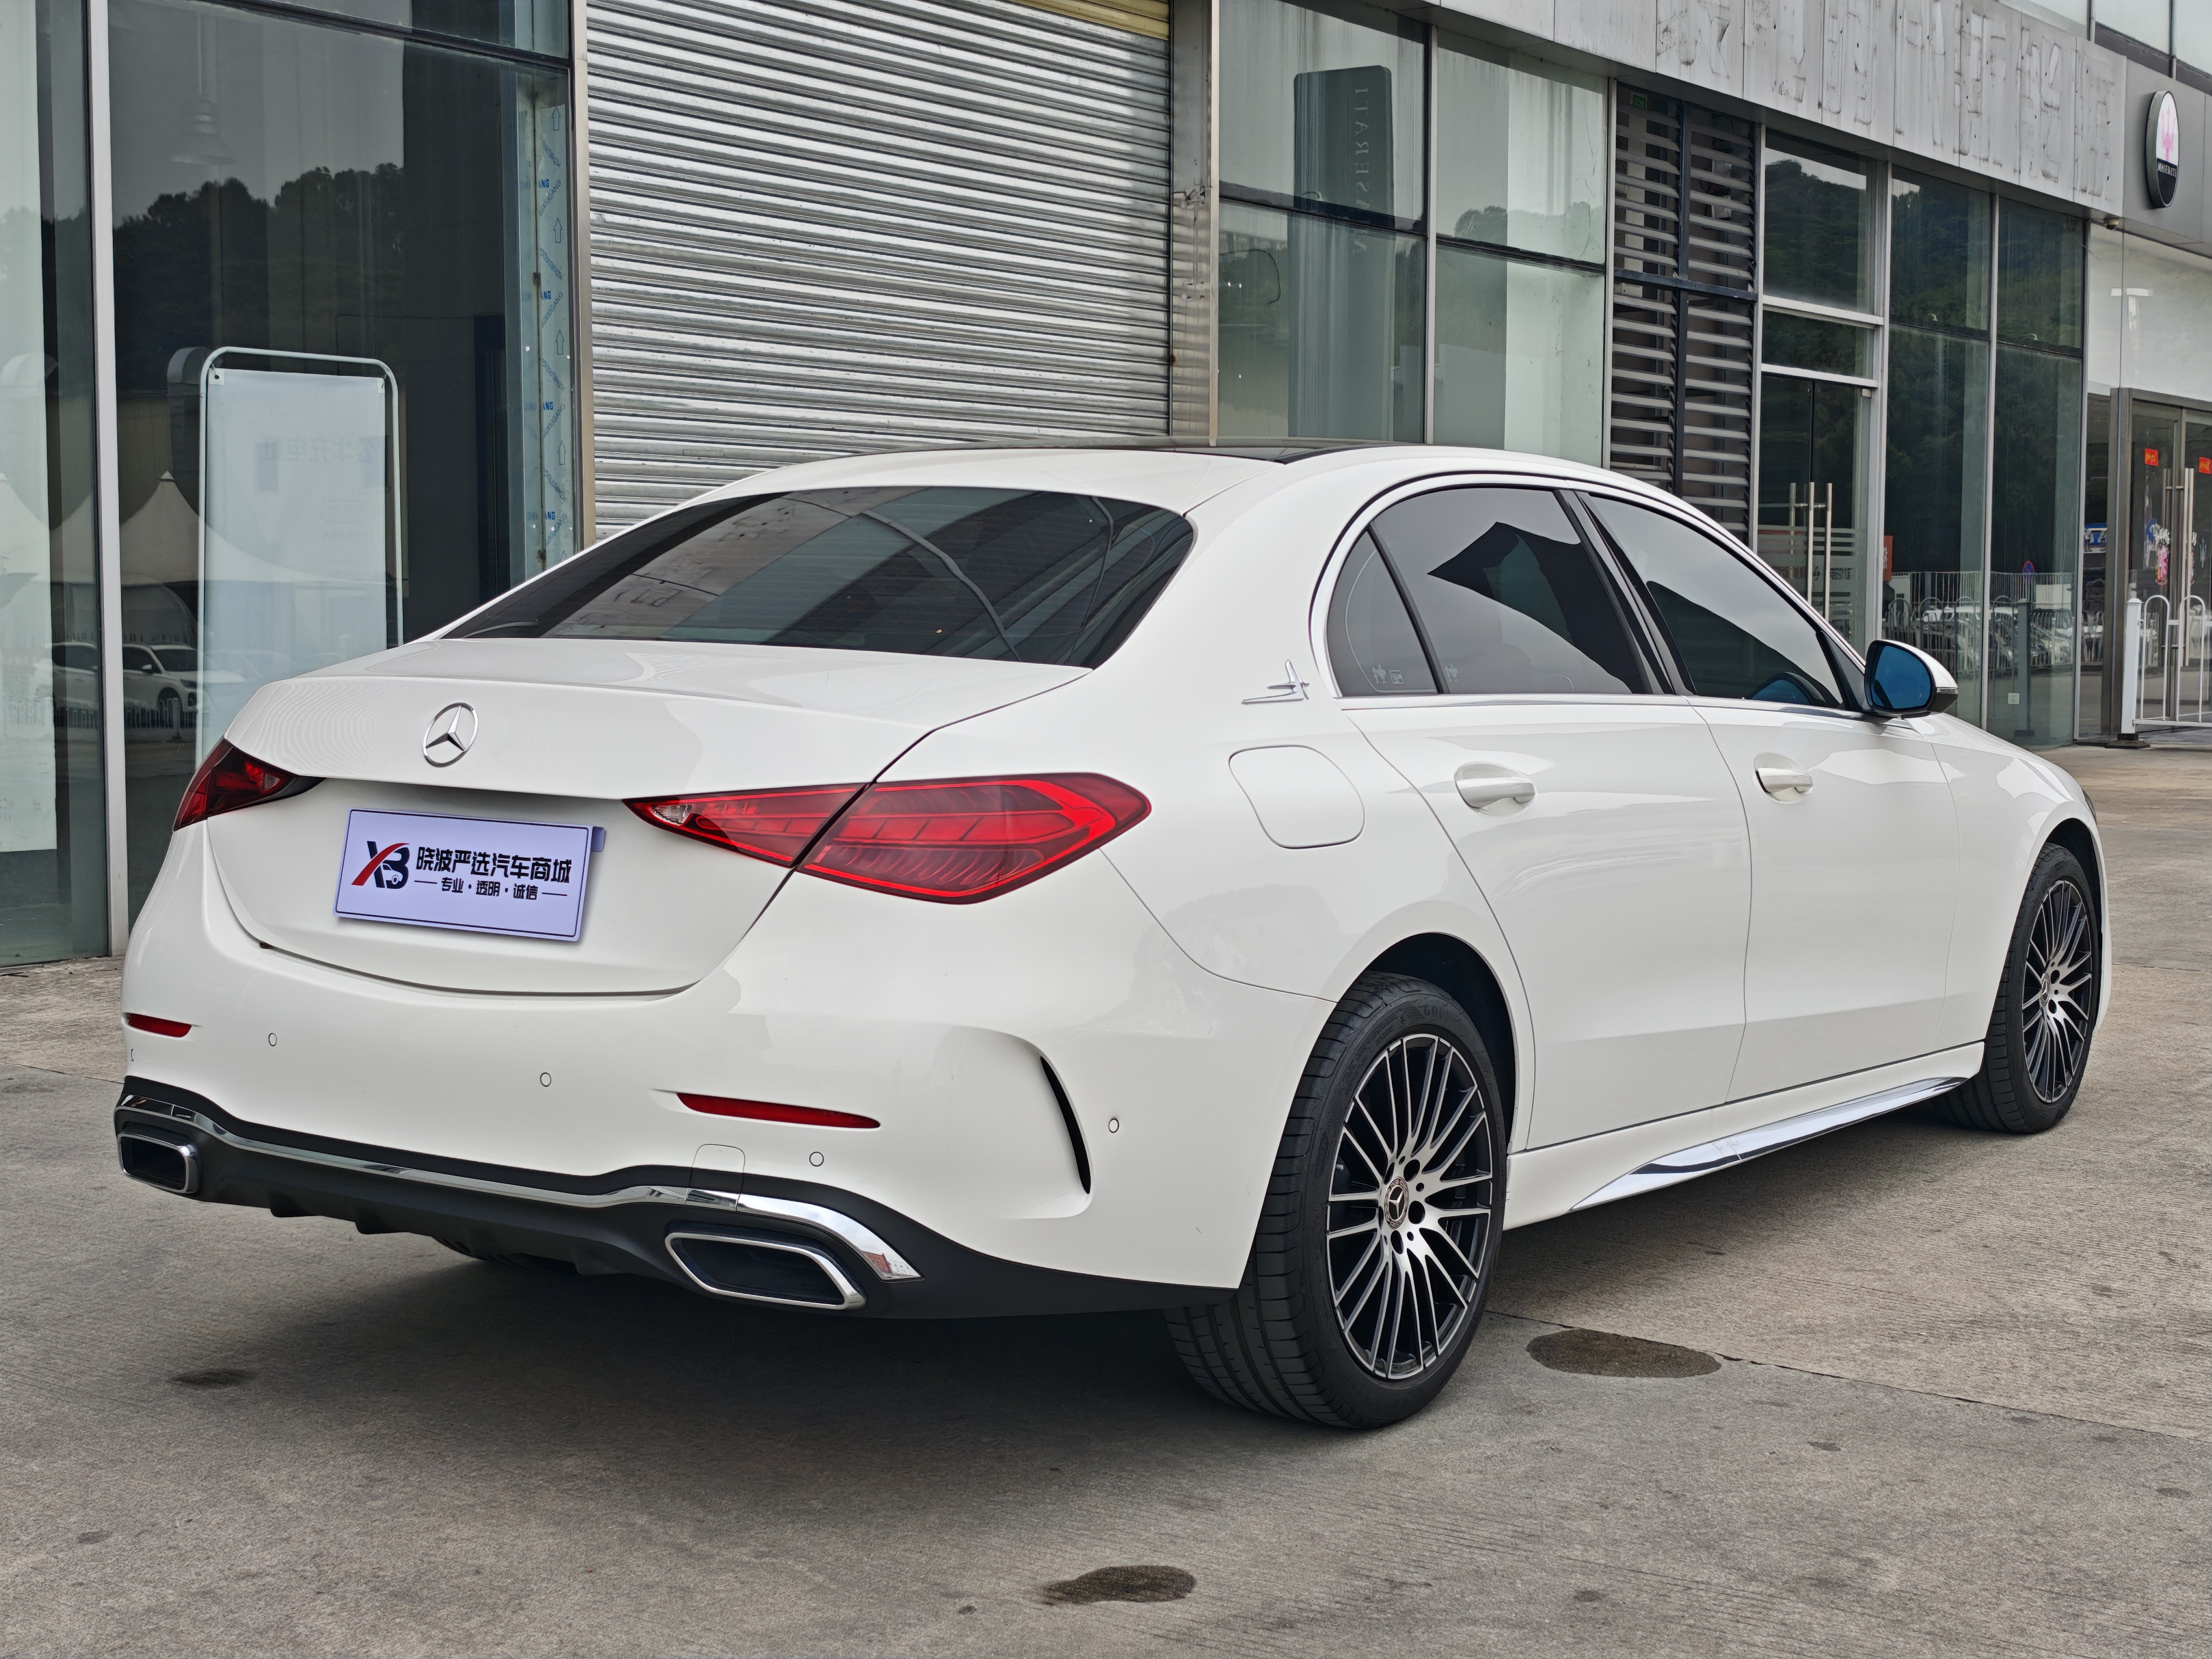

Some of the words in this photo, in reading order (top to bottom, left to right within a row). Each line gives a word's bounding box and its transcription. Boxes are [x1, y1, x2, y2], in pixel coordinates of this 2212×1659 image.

[2157, 162, 2176, 178] MASERATI
[416, 847, 571, 883] 晓波严选汽车商城
